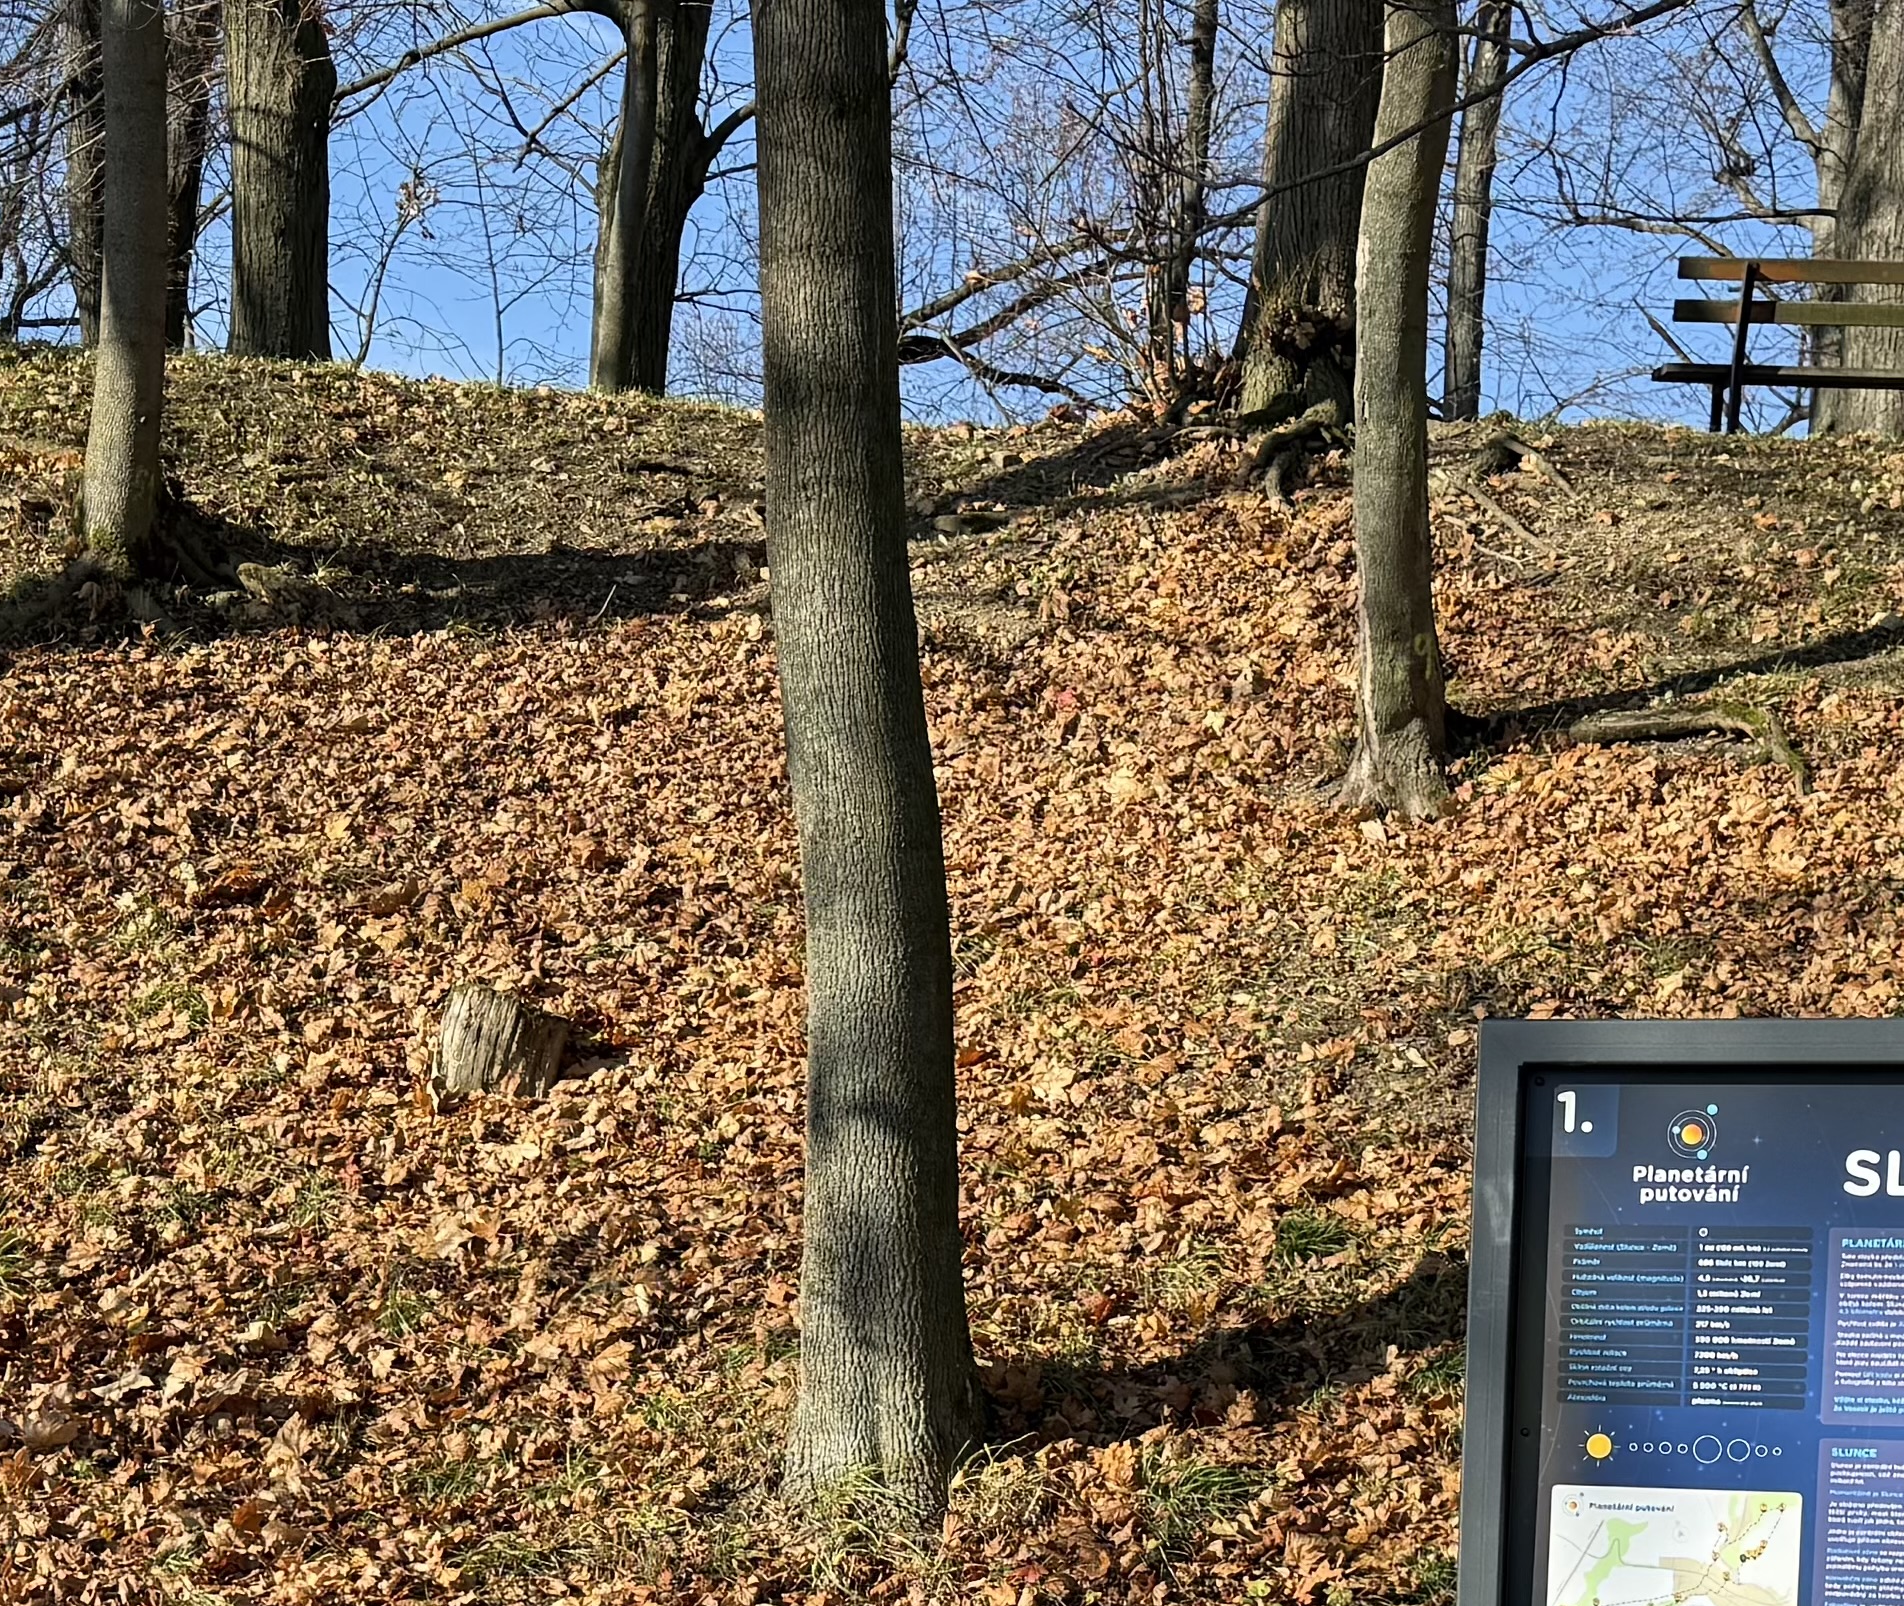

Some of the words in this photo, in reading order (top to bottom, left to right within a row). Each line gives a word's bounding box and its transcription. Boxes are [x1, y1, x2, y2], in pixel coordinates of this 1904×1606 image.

[1557, 1090, 1593, 1133] 1.
[1633, 1164, 1750, 1183] Planetární
[1640, 1184, 1740, 1205] putování
[1831, 1448, 1877, 1458] SLUNCE
